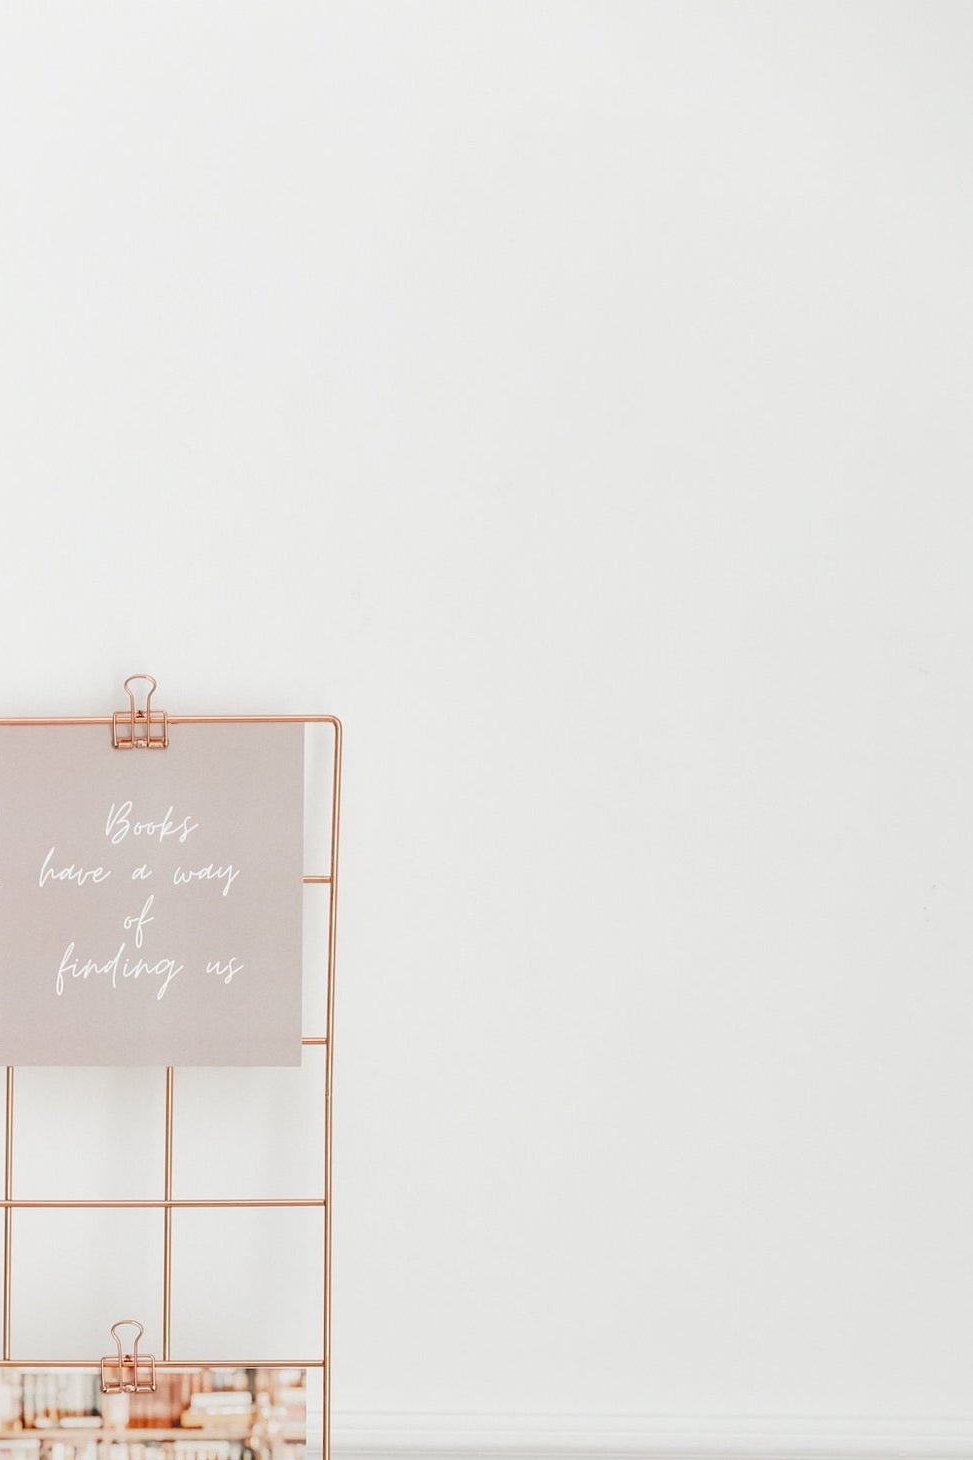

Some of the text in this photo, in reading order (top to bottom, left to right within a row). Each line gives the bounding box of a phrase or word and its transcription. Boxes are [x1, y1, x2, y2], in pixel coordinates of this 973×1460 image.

[105, 800, 199, 844] Books
[39, 847, 240, 896] have a way
[124, 894, 154, 948] of
[56, 942, 244, 1000] finding us
